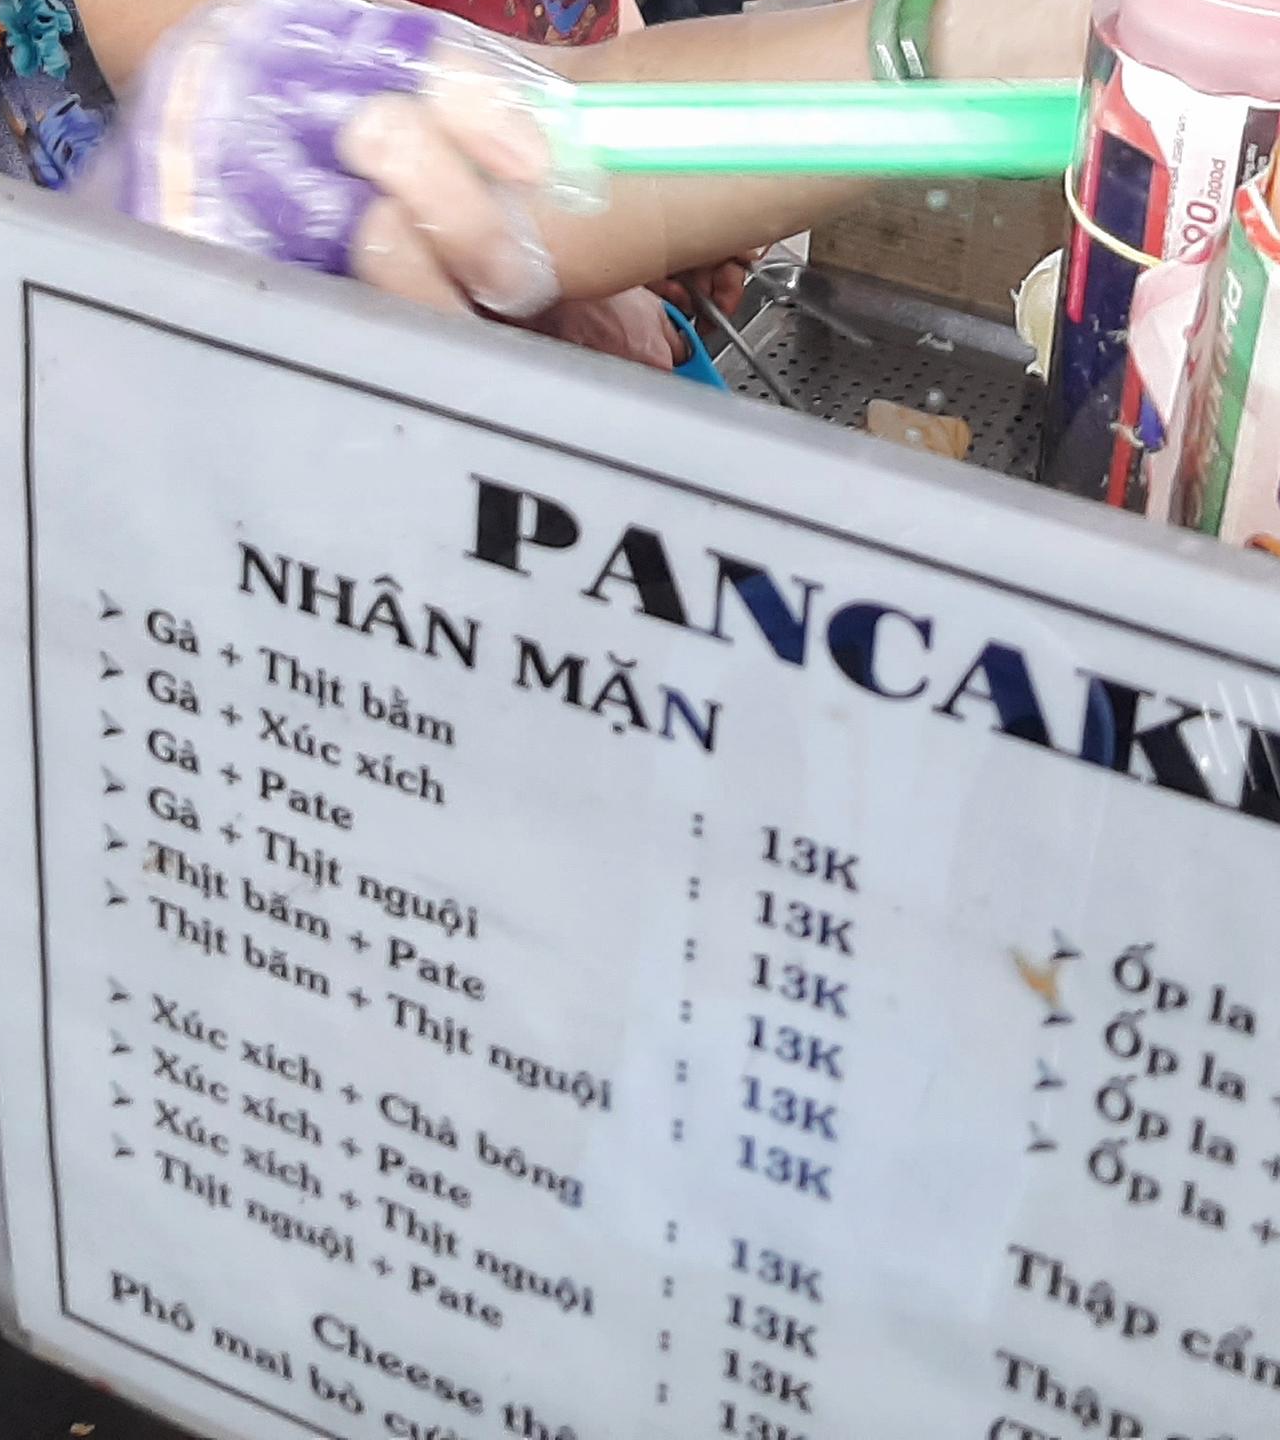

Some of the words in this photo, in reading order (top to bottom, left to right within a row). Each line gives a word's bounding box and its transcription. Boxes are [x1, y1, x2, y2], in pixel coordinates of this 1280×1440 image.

[144, 608, 200, 657] Gà
[218, 643, 243, 667] +
[258, 646, 345, 709] Thịt
[761, 825, 860, 893] 13K
[236, 540, 481, 672] NHÂN
[512, 634, 723, 755] MẶN
[145, 728, 201, 776] Gà
[219, 763, 242, 786] +
[259, 767, 354, 832] Pate
[751, 953, 849, 1020] 13K
[146, 668, 201, 717] Gà
[220, 704, 242, 728] +
[259, 707, 341, 768] Xúc
[356, 752, 445, 807] xích
[756, 890, 854, 957] 13K
[147, 786, 201, 833] Gà
[219, 823, 242, 845] +
[256, 826, 342, 892] Thịt
[357, 875, 478, 940] nguội
[746, 1014, 845, 1081] 13K
[147, 840, 228, 900] Thịt
[347, 931, 371, 954] +
[388, 936, 485, 1001] Pate
[742, 1074, 839, 1142] 13K
[148, 896, 228, 956] Thịt
[347, 987, 372, 1010] +
[387, 991, 472, 1055] Thịt
[488, 1044, 612, 1112] nguội
[737, 1134, 833, 1202] 13K
[1102, 1008, 1180, 1080] Ốp
[1198, 1052, 1246, 1104] la
[1110, 942, 1190, 1014] Ốp
[1207, 984, 1257, 1038] la
[152, 993, 228, 1051] Xúc
[241, 1040, 323, 1093] xích
[340, 1084, 362, 1105] +
[376, 1092, 459, 1151] Chà
[476, 1130, 584, 1209] bông
[731, 1237, 824, 1306] 13K
[153, 1046, 229, 1104] Xúc
[242, 1094, 323, 1147] xích
[339, 1137, 362, 1158] +
[377, 1143, 471, 1209] Pate
[727, 1293, 818, 1362] 13K
[155, 1150, 232, 1208] Thịt
[245, 1199, 355, 1265] nguội
[371, 1256, 393, 1276] +
[408, 1263, 503, 1330] Pate
[1085, 1137, 1162, 1207] Ốp
[1178, 1181, 1227, 1232] la
[1252, 1219, 1280, 1246] +
[1094, 1074, 1171, 1143] Ốp
[1188, 1116, 1238, 1169] la
[110, 1270, 195, 1334] Phô
[212, 1327, 293, 1382] mai
[308, 1363, 365, 1416] bò
[154, 1099, 229, 1157] Xúc
[243, 1146, 323, 1200] xích
[339, 1190, 361, 1210] +
[376, 1196, 459, 1258] Thịt
[473, 1249, 594, 1317] nguội
[723, 1347, 813, 1415] 13K
[311, 1313, 483, 1416] Cheese
[1008, 1243, 1160, 1341] Thập
